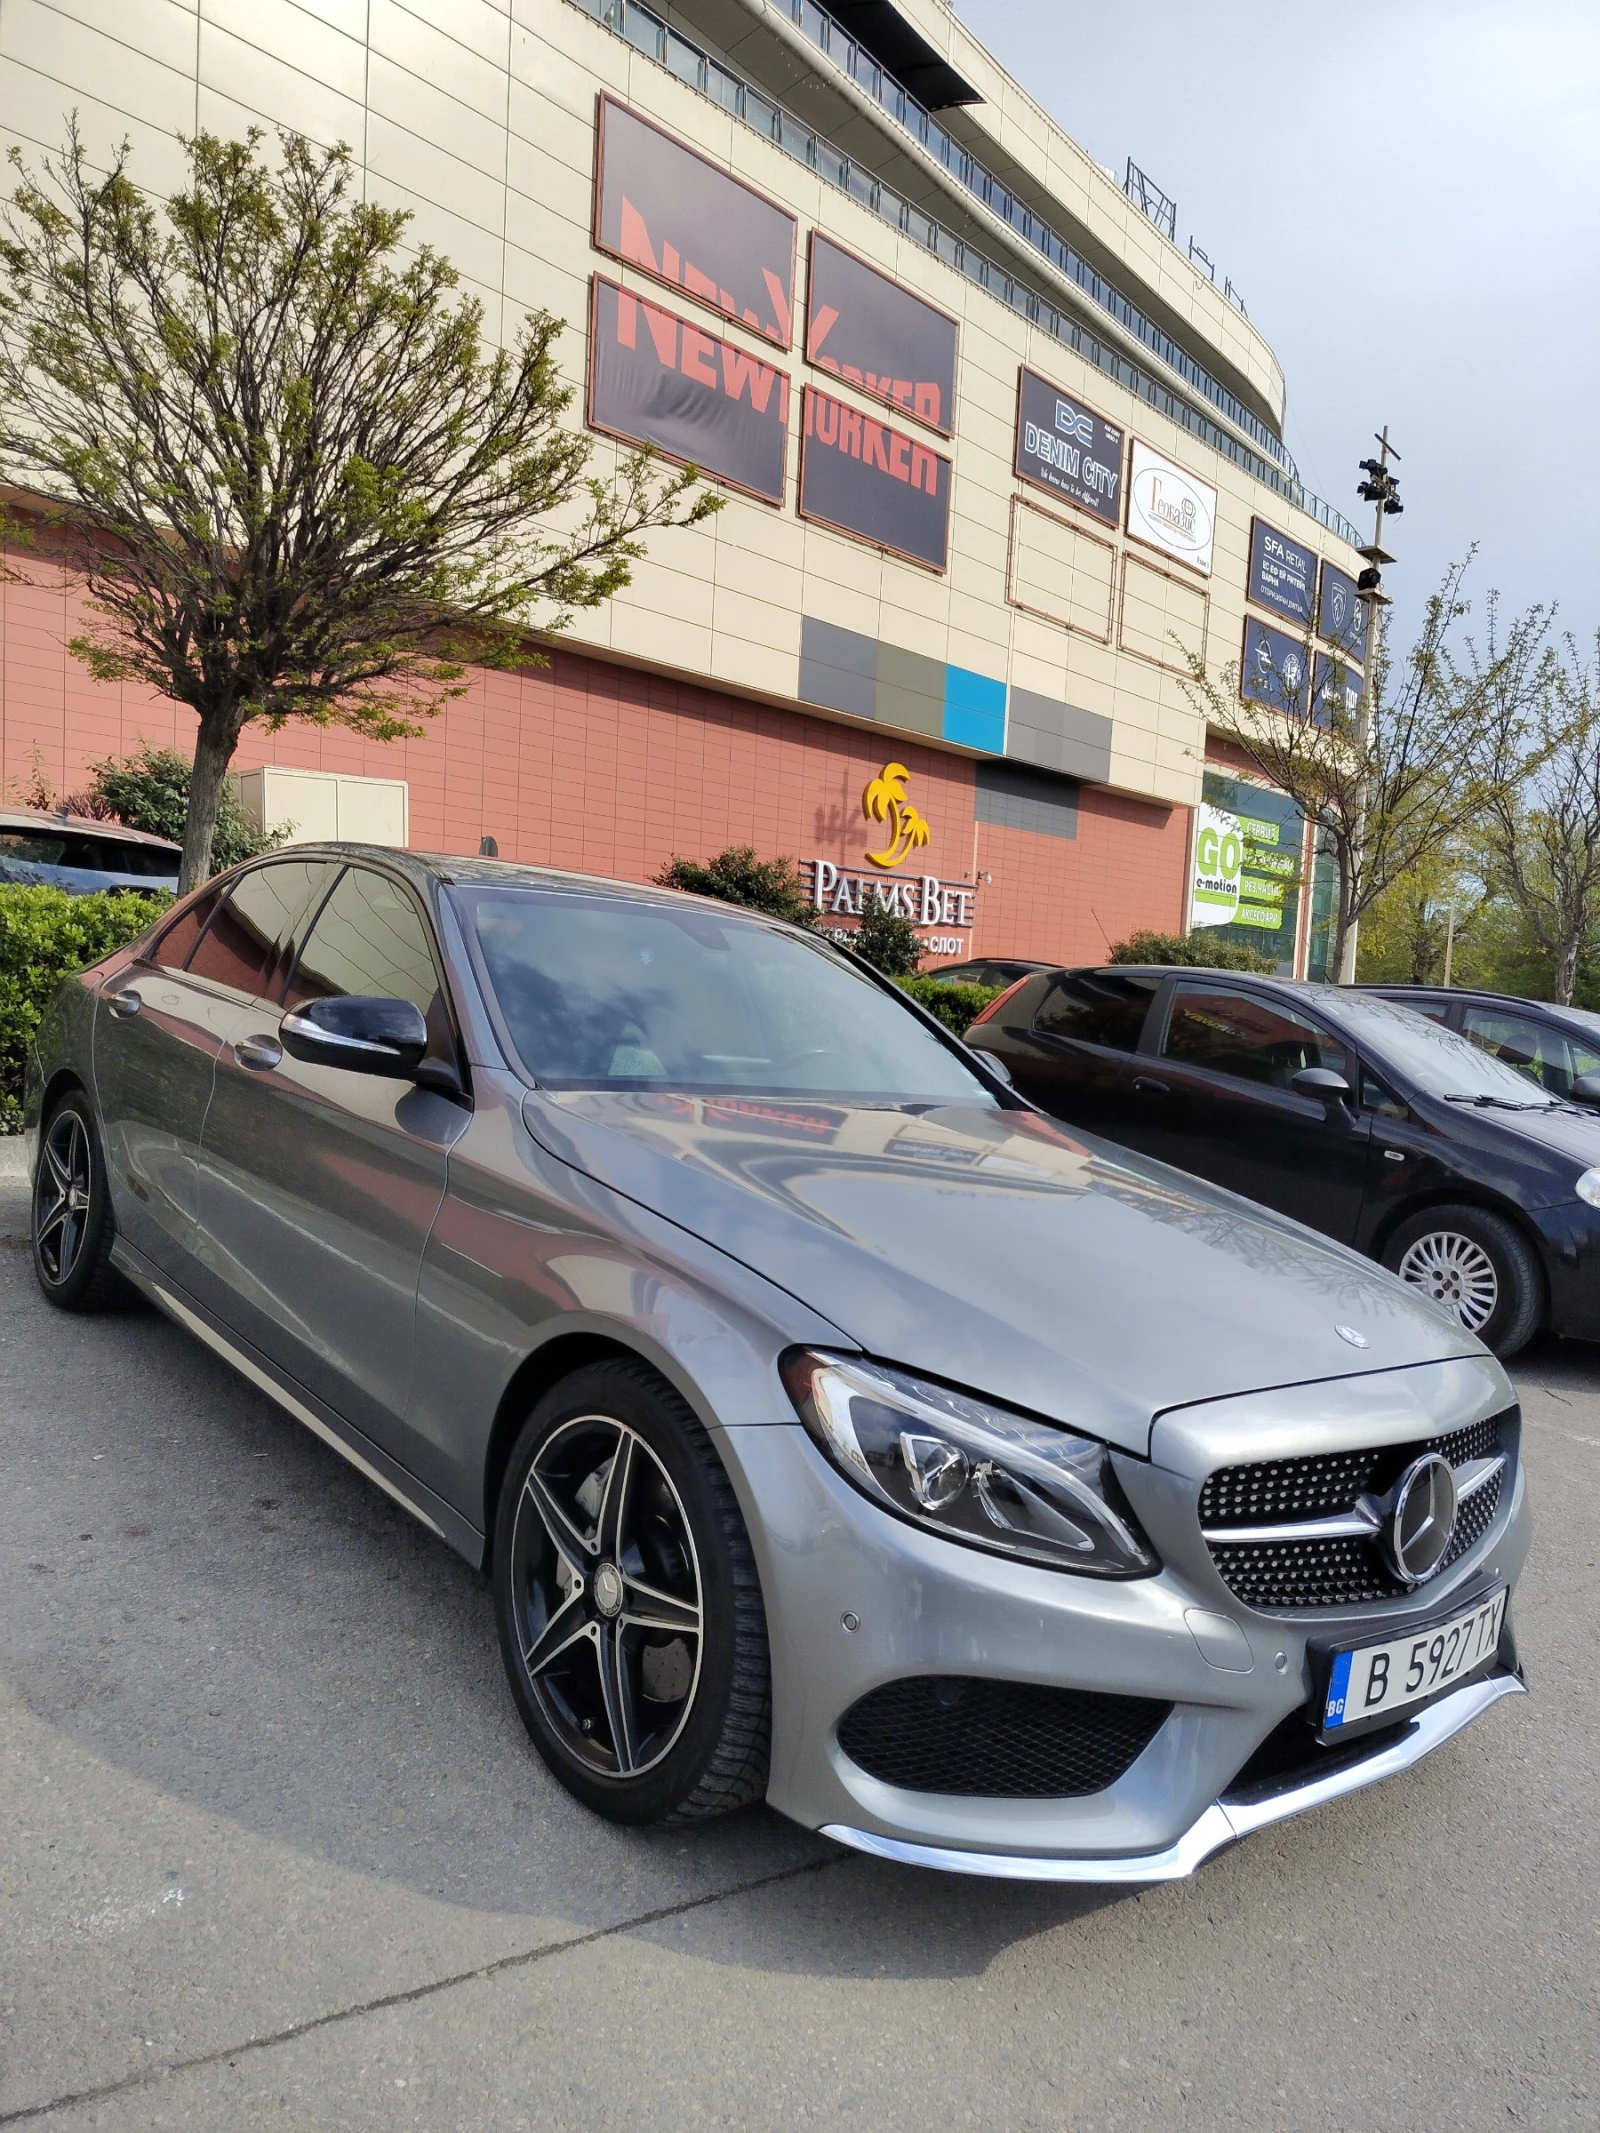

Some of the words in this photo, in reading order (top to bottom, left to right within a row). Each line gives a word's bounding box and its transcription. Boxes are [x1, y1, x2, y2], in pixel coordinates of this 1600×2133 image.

[617, 196, 779, 414] NEW
[762, 267, 942, 497] YORKER
[1025, 421, 1080, 479] DENIM
[1082, 456, 1118, 499] CITY
[1264, 535, 1285, 560] SFA
[1285, 549, 1307, 574] RETAIL
[1261, 570, 1279, 588] ВАРНА
[1197, 826, 1241, 881] GO
[814, 859, 915, 919] PALMS
[920, 875, 972, 925] BET
[1196, 877, 1237, 894] e-motion
[1241, 907, 1278, 924] АКСЕСОАРИ
[928, 935, 965, 955] СЛОТ
[1364, 1652, 1391, 1708] B
[1405, 1617, 1476, 1693] 5927
[1475, 1597, 1503, 1658] TX
[1326, 1698, 1345, 1718] BG
